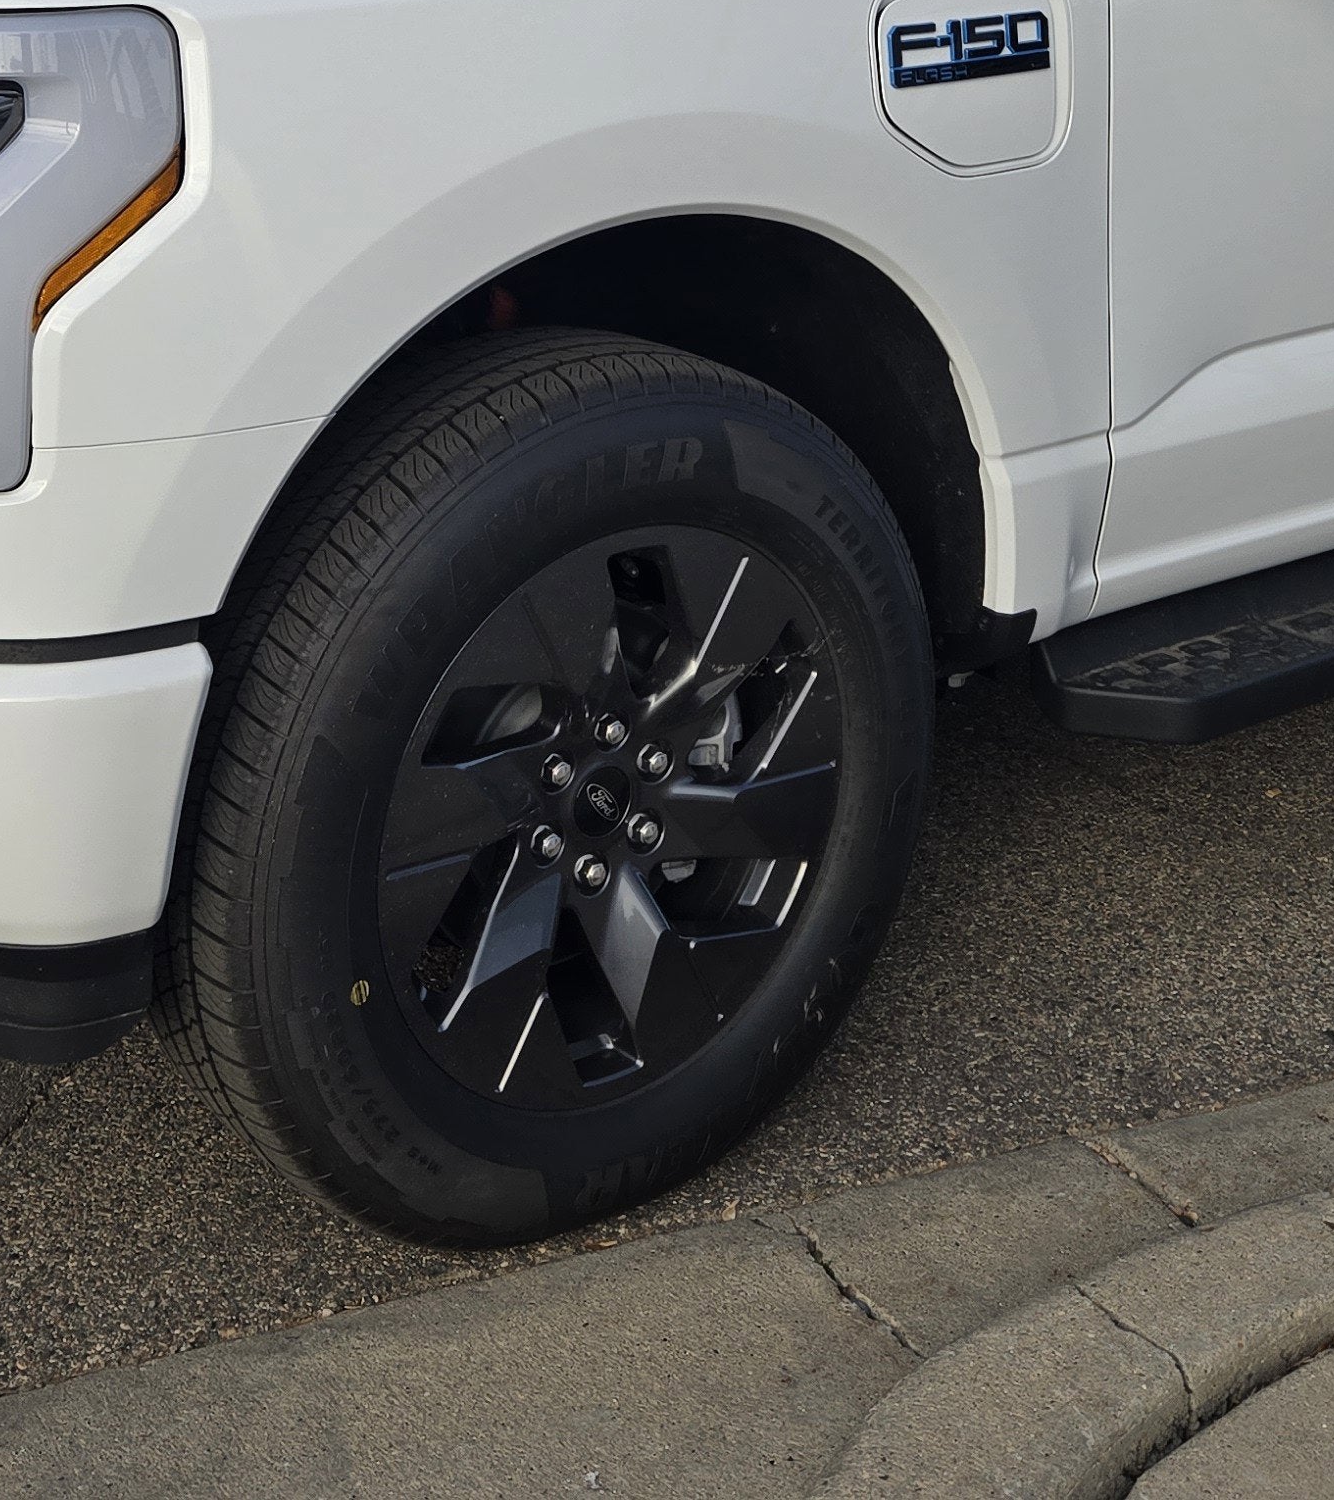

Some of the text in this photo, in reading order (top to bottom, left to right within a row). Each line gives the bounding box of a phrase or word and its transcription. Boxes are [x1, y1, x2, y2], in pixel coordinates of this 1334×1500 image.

[887, 10, 1049, 69] F-150
[900, 63, 969, 85] FLASH
[591, 790, 616, 816] Ford
